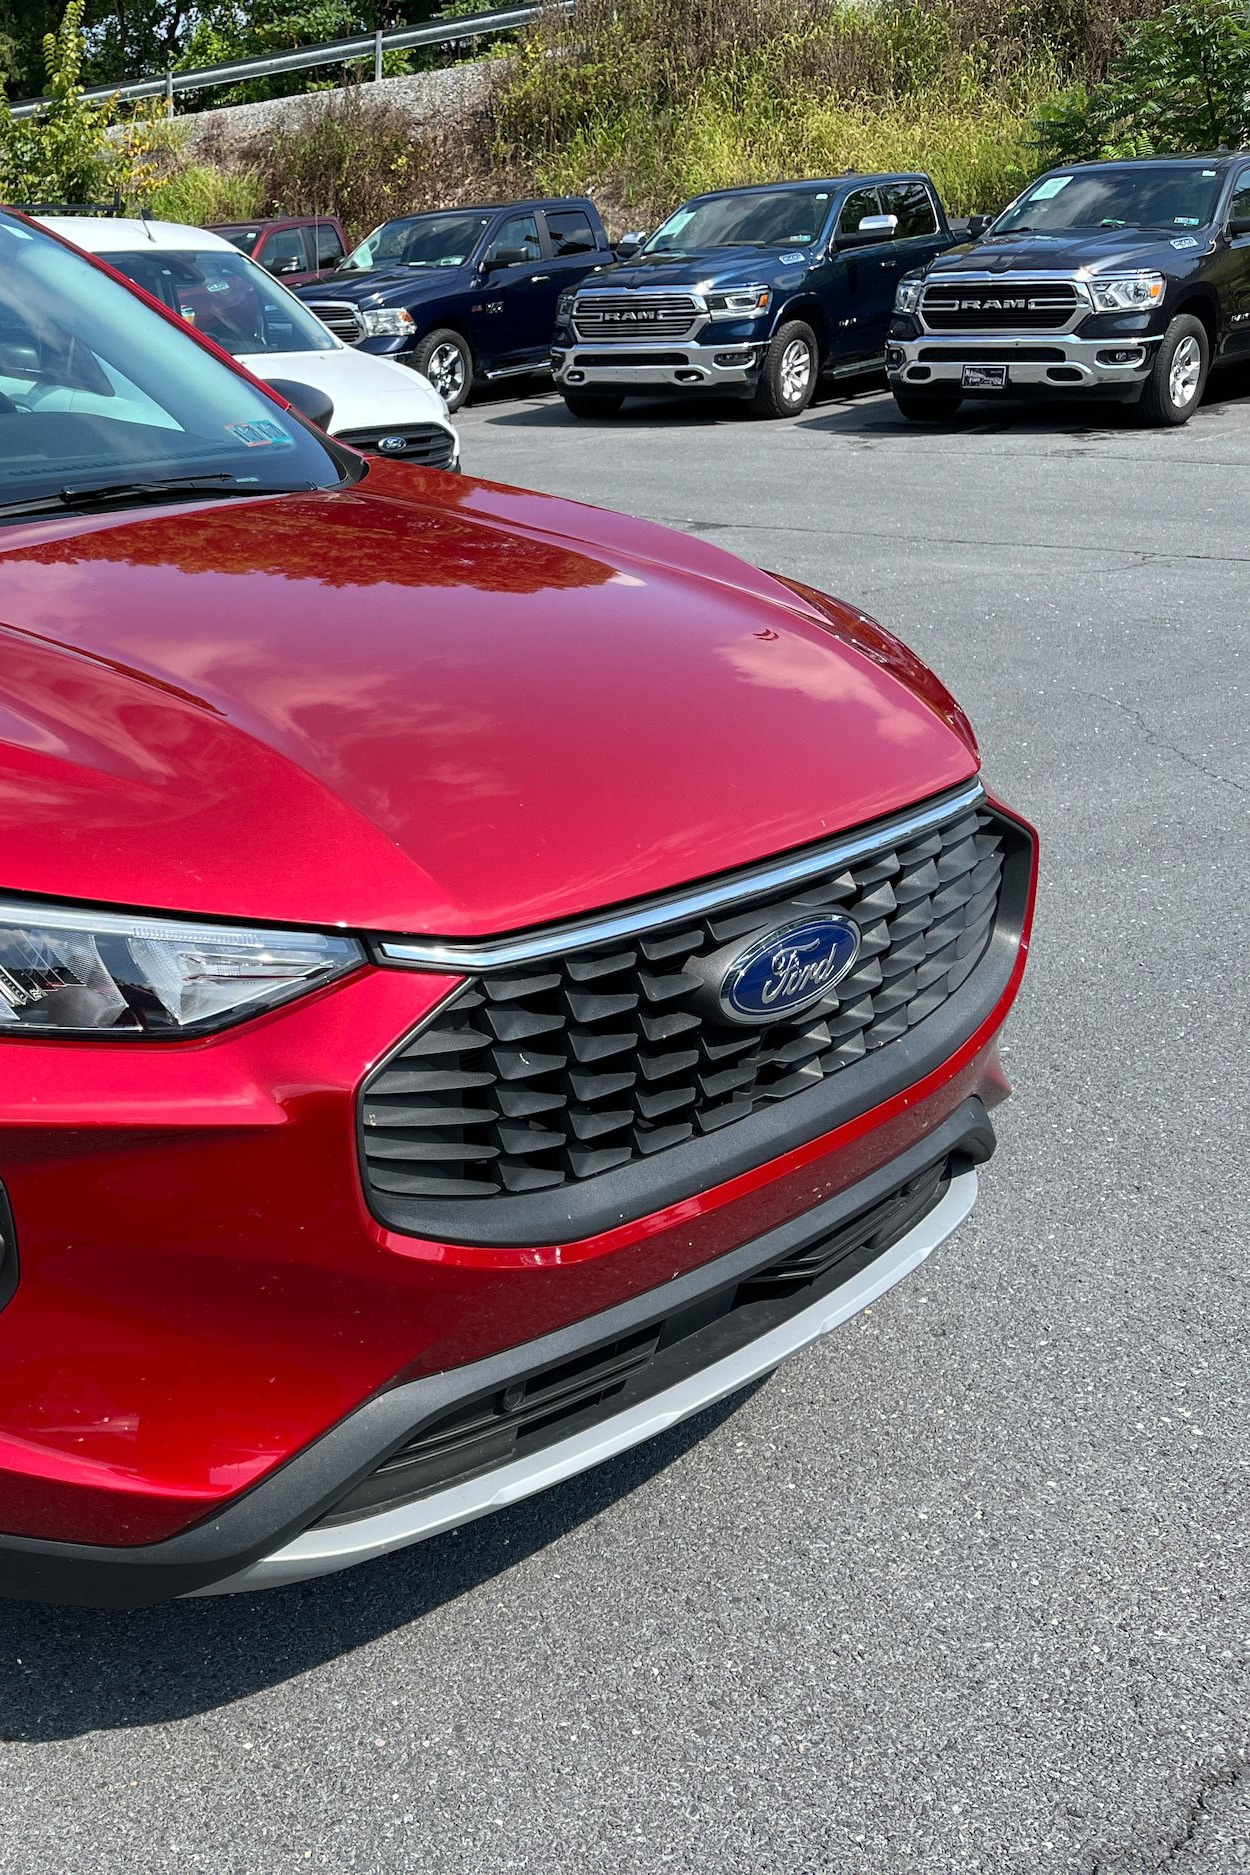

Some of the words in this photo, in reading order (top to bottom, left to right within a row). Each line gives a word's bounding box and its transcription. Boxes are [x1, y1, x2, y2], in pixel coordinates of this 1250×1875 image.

[961, 299, 1026, 310] RAM
[604, 311, 655, 321] RAM
[762, 938, 838, 1004] Ford
